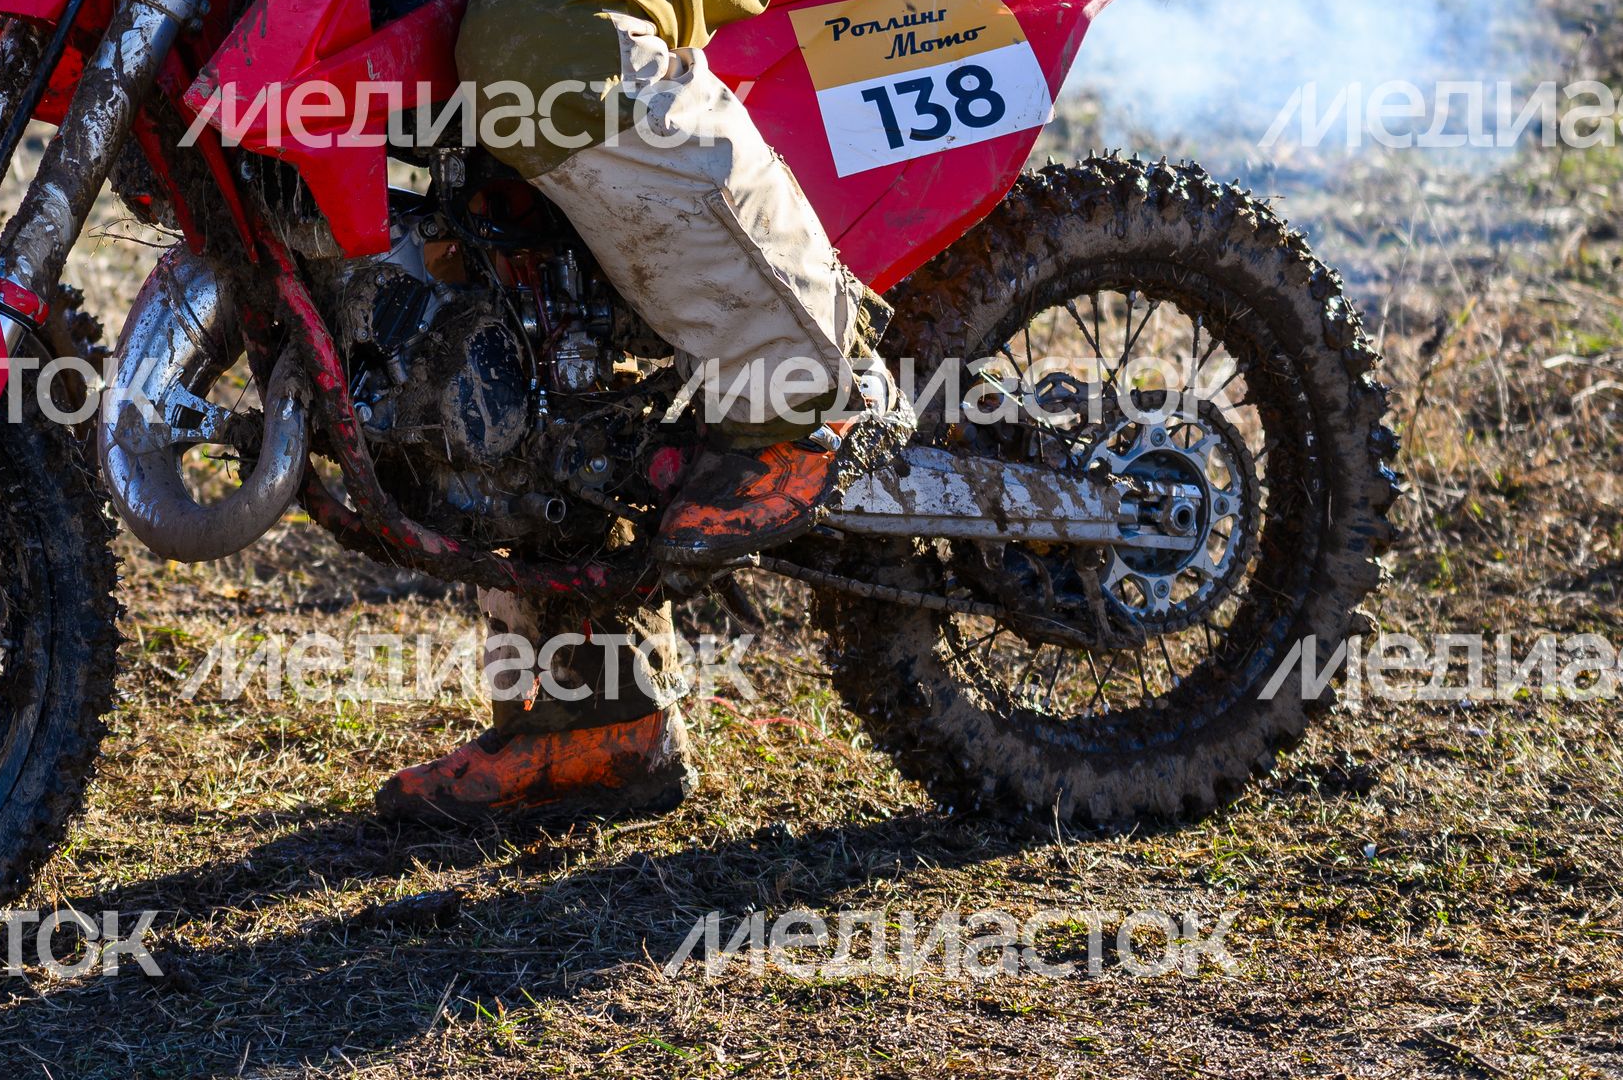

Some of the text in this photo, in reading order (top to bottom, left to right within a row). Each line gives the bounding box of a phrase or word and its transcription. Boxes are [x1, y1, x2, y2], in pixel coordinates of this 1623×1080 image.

[824, 8, 947, 42] Роллинг
[884, 25, 987, 60] Мото
[860, 64, 1006, 150] 138
